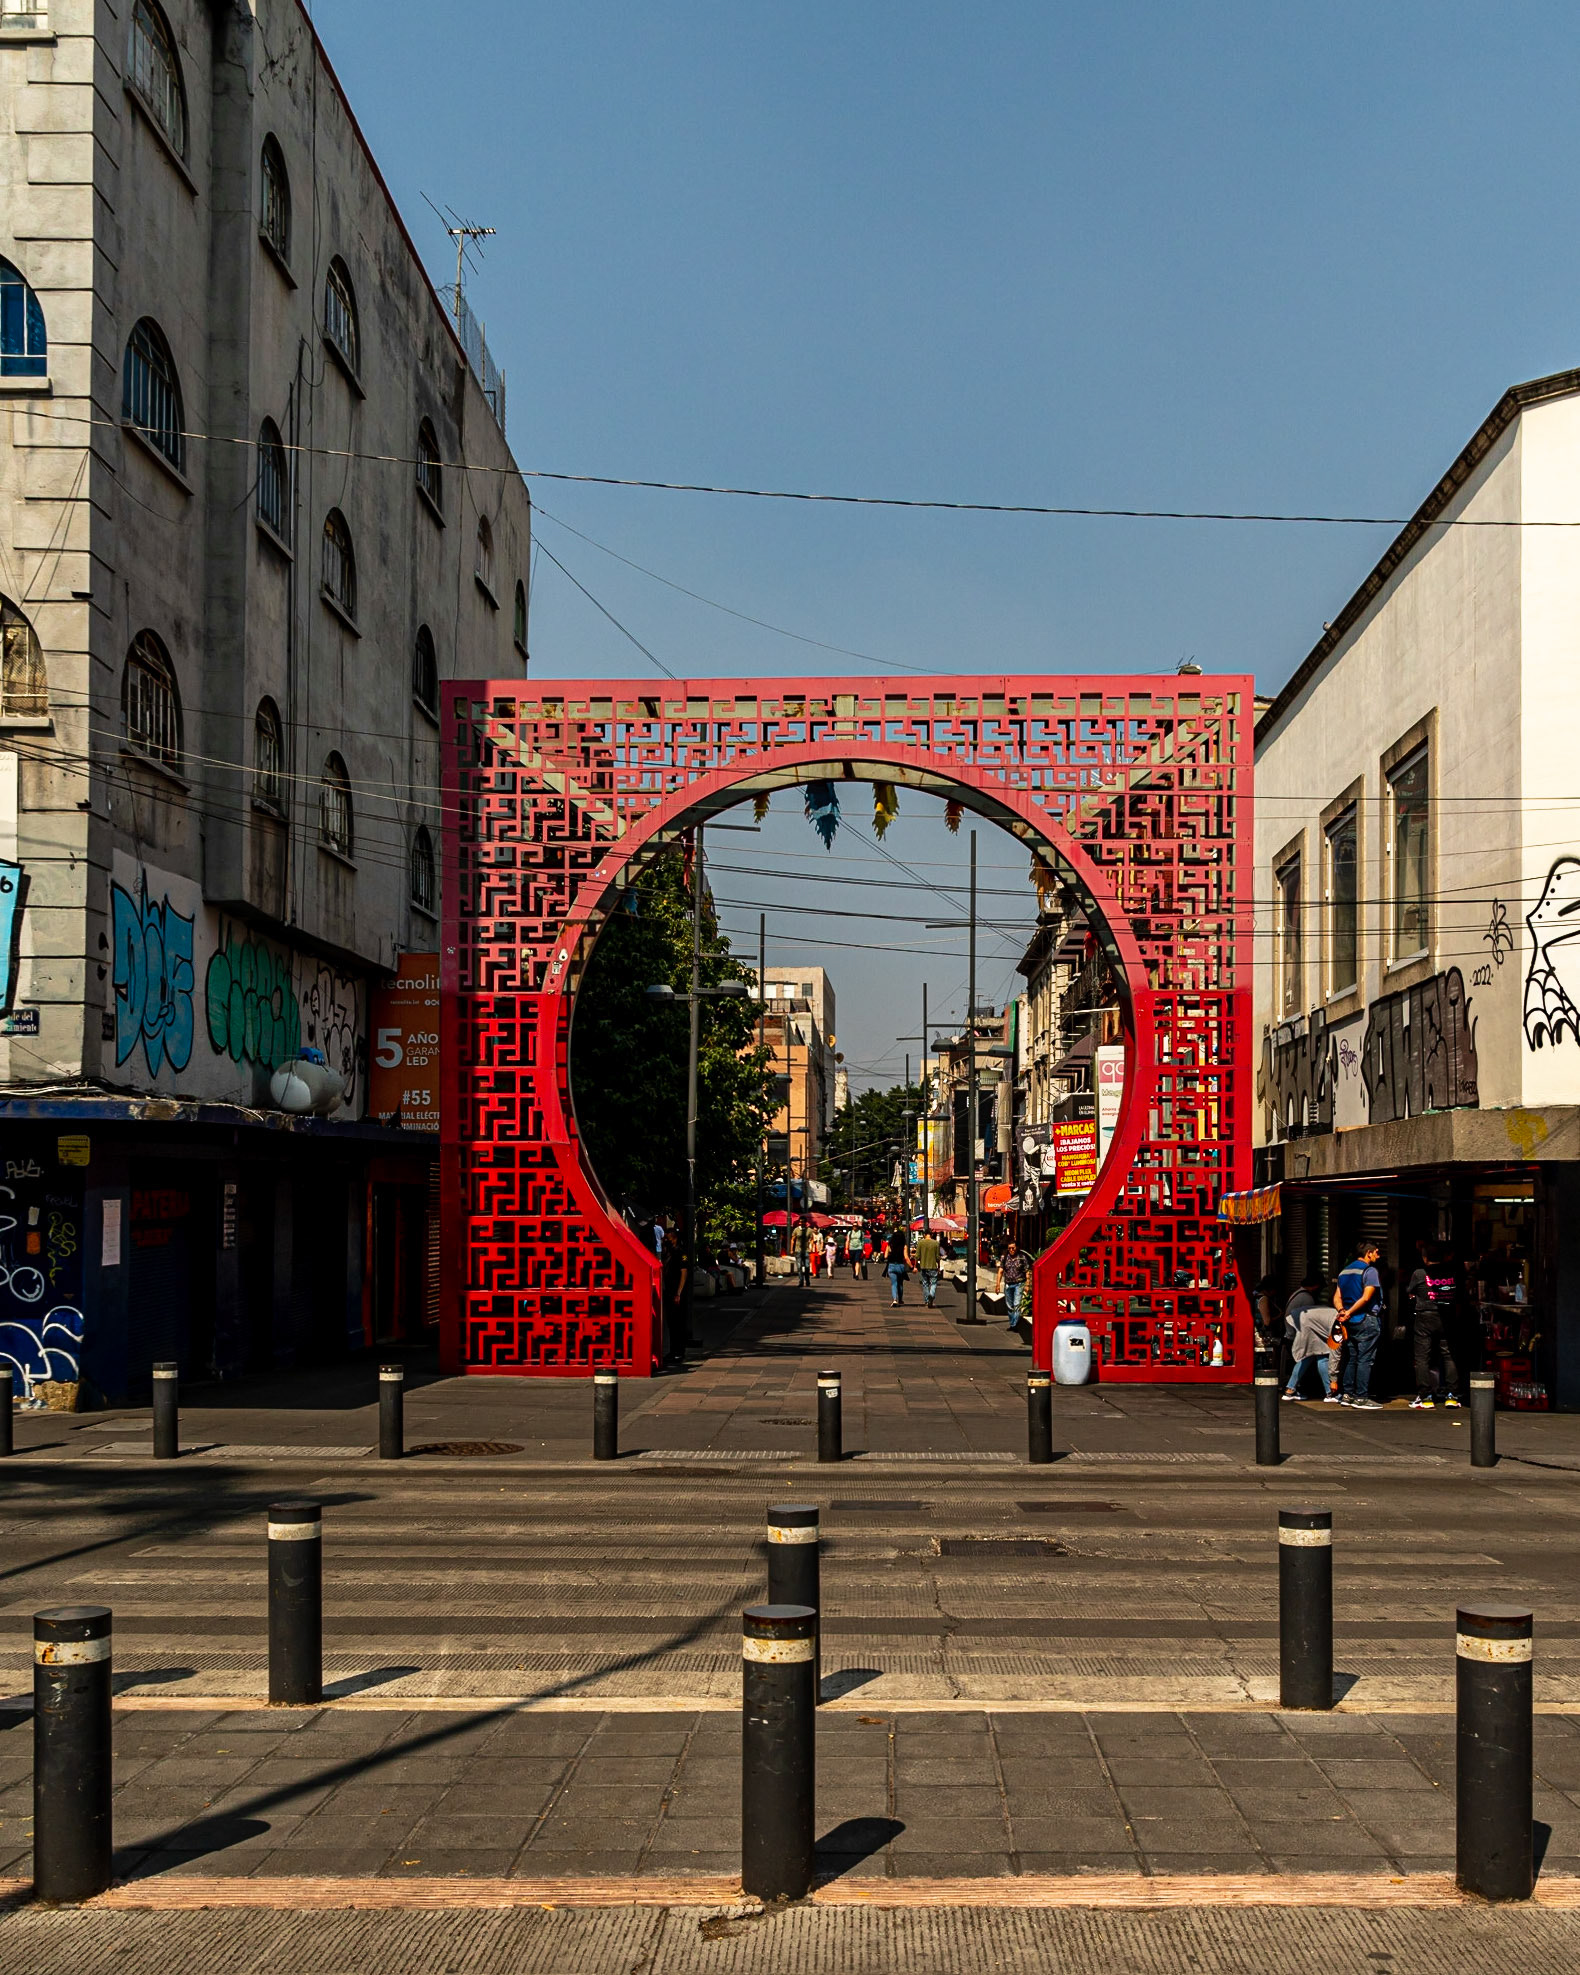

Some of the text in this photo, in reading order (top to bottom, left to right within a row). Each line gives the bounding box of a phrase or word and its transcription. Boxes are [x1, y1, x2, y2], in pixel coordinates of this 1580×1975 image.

[22, 1011, 33, 1021] del
[375, 1028, 404, 1069] 5
[406, 1056, 429, 1066] LED
[402, 1090, 431, 1105] #55
